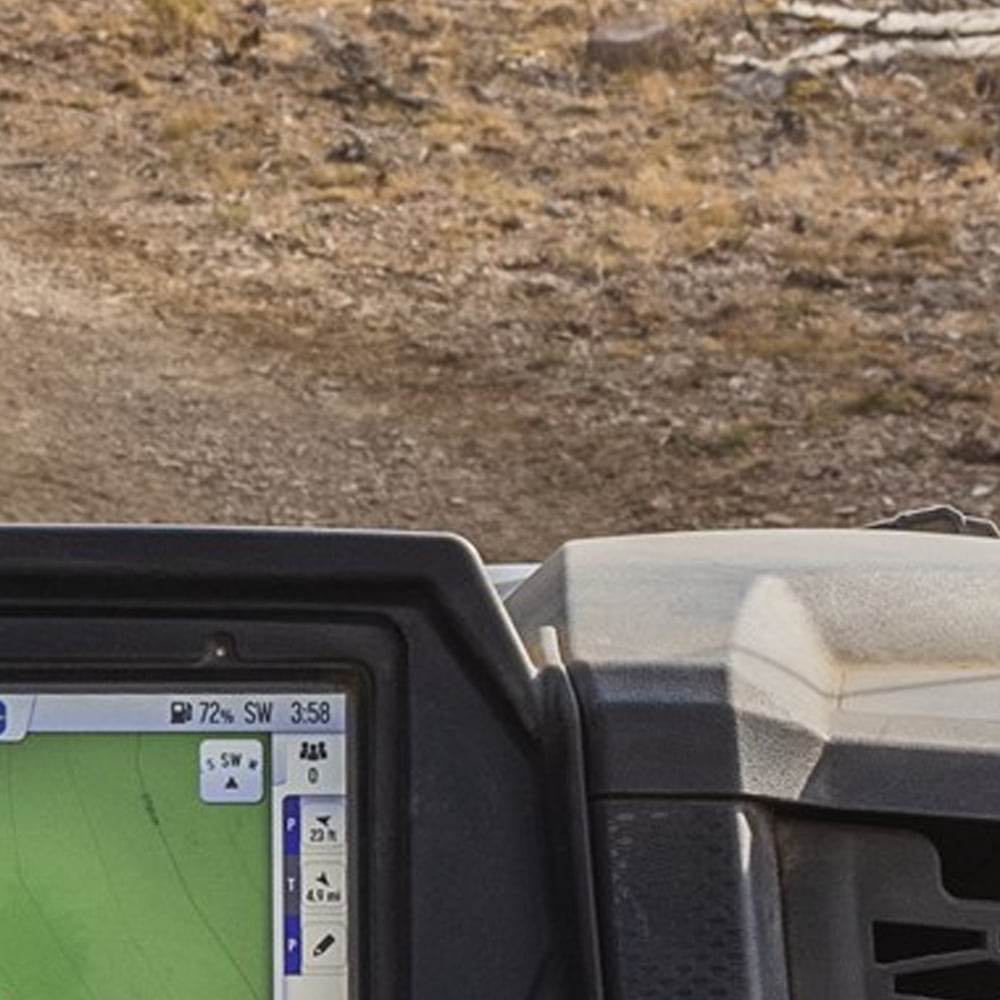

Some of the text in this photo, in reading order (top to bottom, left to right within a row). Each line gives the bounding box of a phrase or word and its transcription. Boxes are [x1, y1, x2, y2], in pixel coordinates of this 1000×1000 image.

[199, 701, 331, 724] 72% SW 3:58
[221, 754, 242, 768] SW
[308, 768, 319, 784] 0
[310, 828, 325, 842] 23
